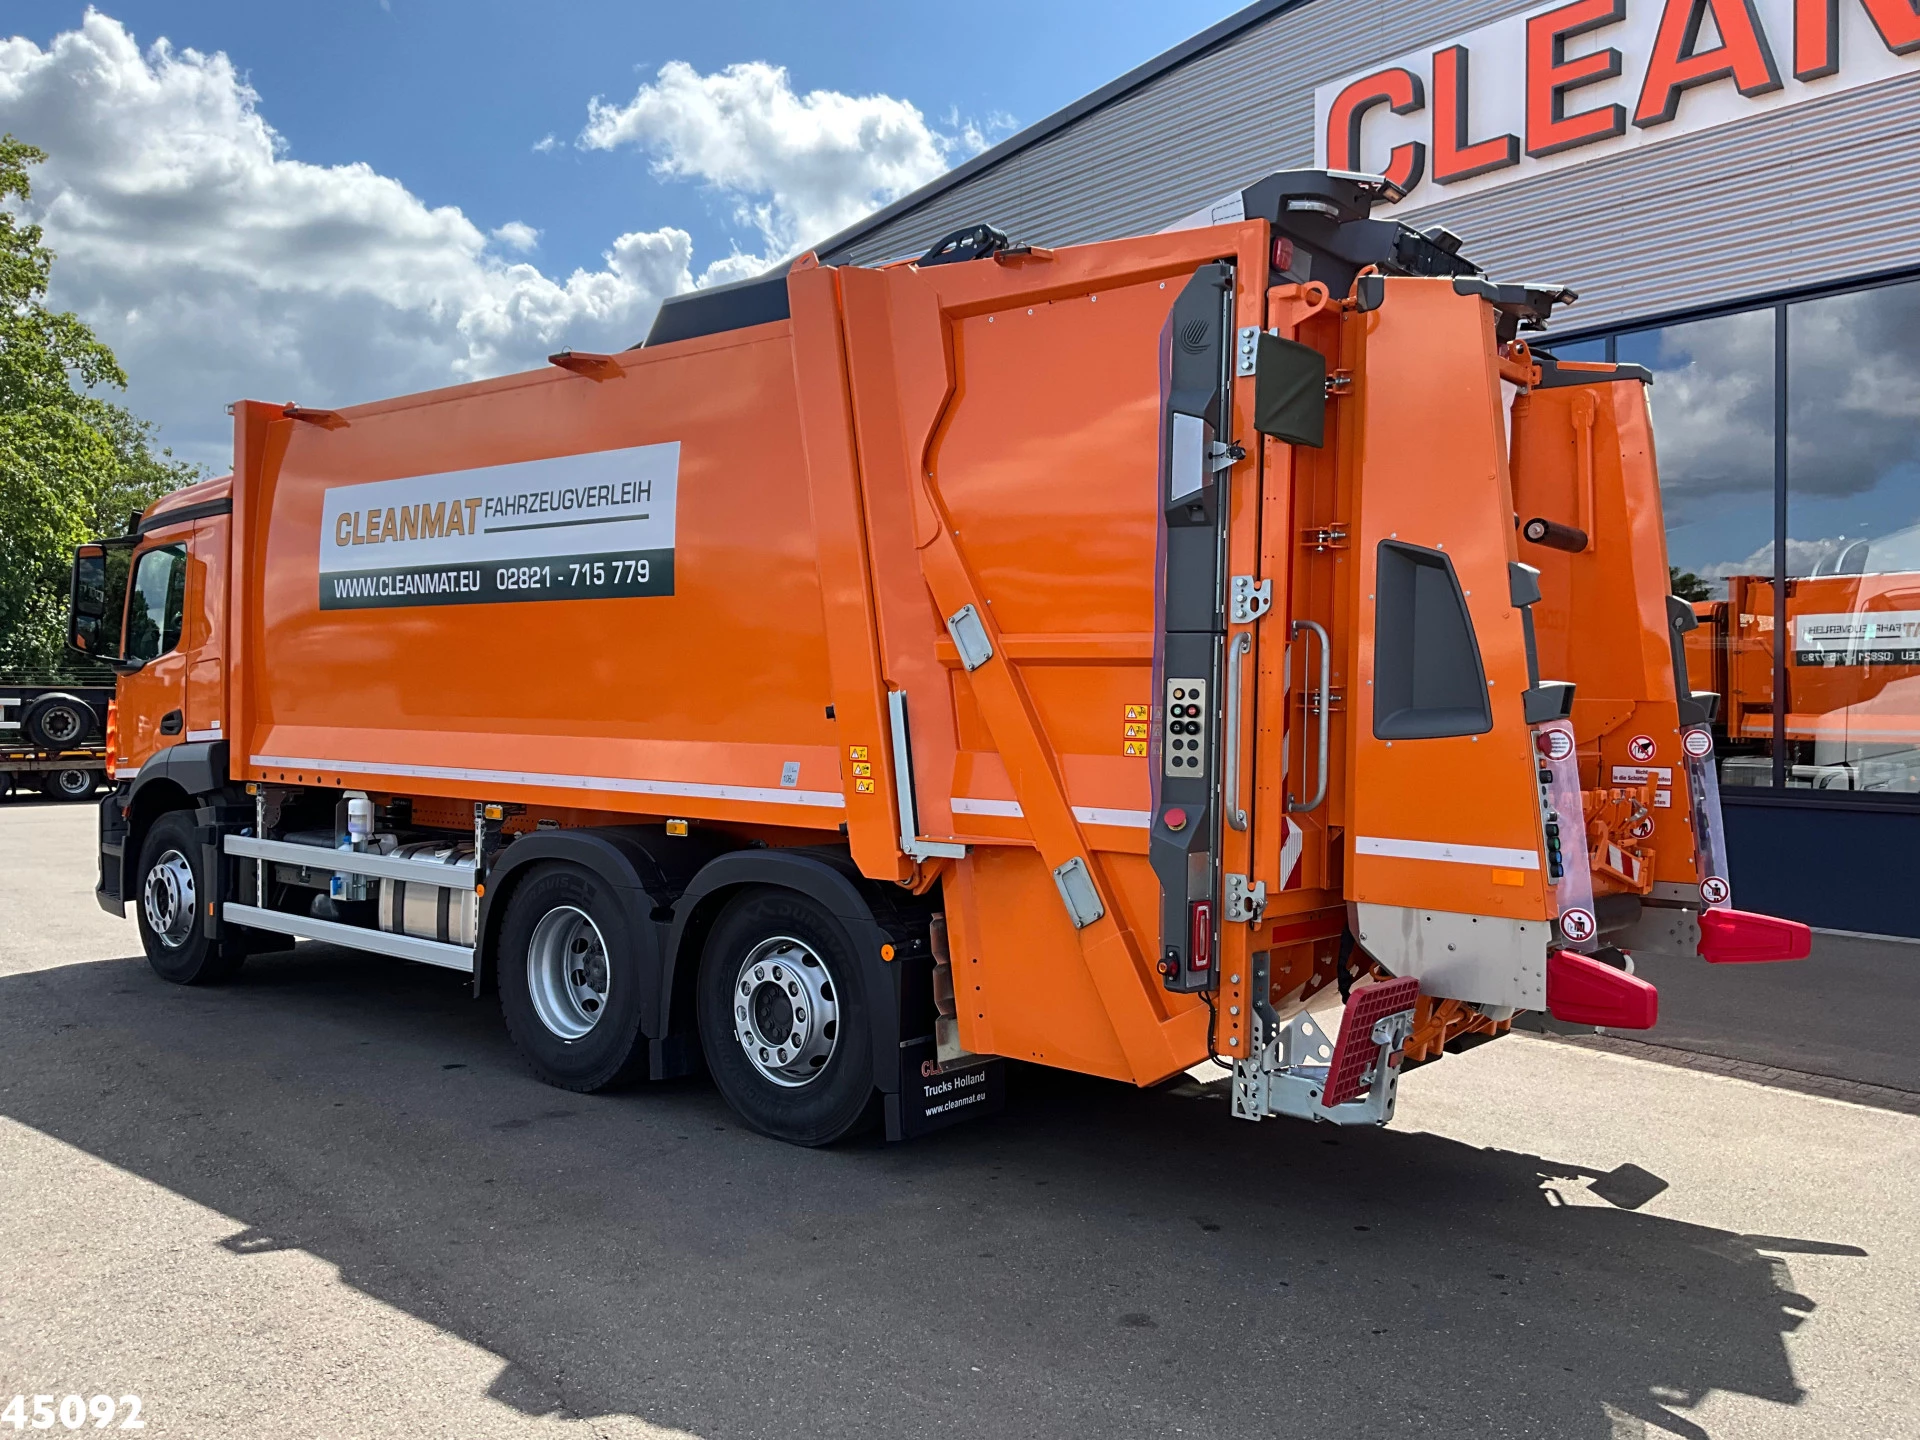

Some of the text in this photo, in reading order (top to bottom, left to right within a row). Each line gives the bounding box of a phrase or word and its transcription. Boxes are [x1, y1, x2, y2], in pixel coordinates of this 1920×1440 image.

[335, 480, 652, 547] CLEANMAT FAHRZEUGVERLEIH
[334, 570, 480, 598] WWW.CLEANMAT.EU
[496, 566, 551, 590] 02821
[569, 562, 604, 586] 715
[612, 559, 650, 584] 779
[924, 1071, 985, 1097] Trucks Holland
[926, 1093, 986, 1116] www.cleanmat.eu
